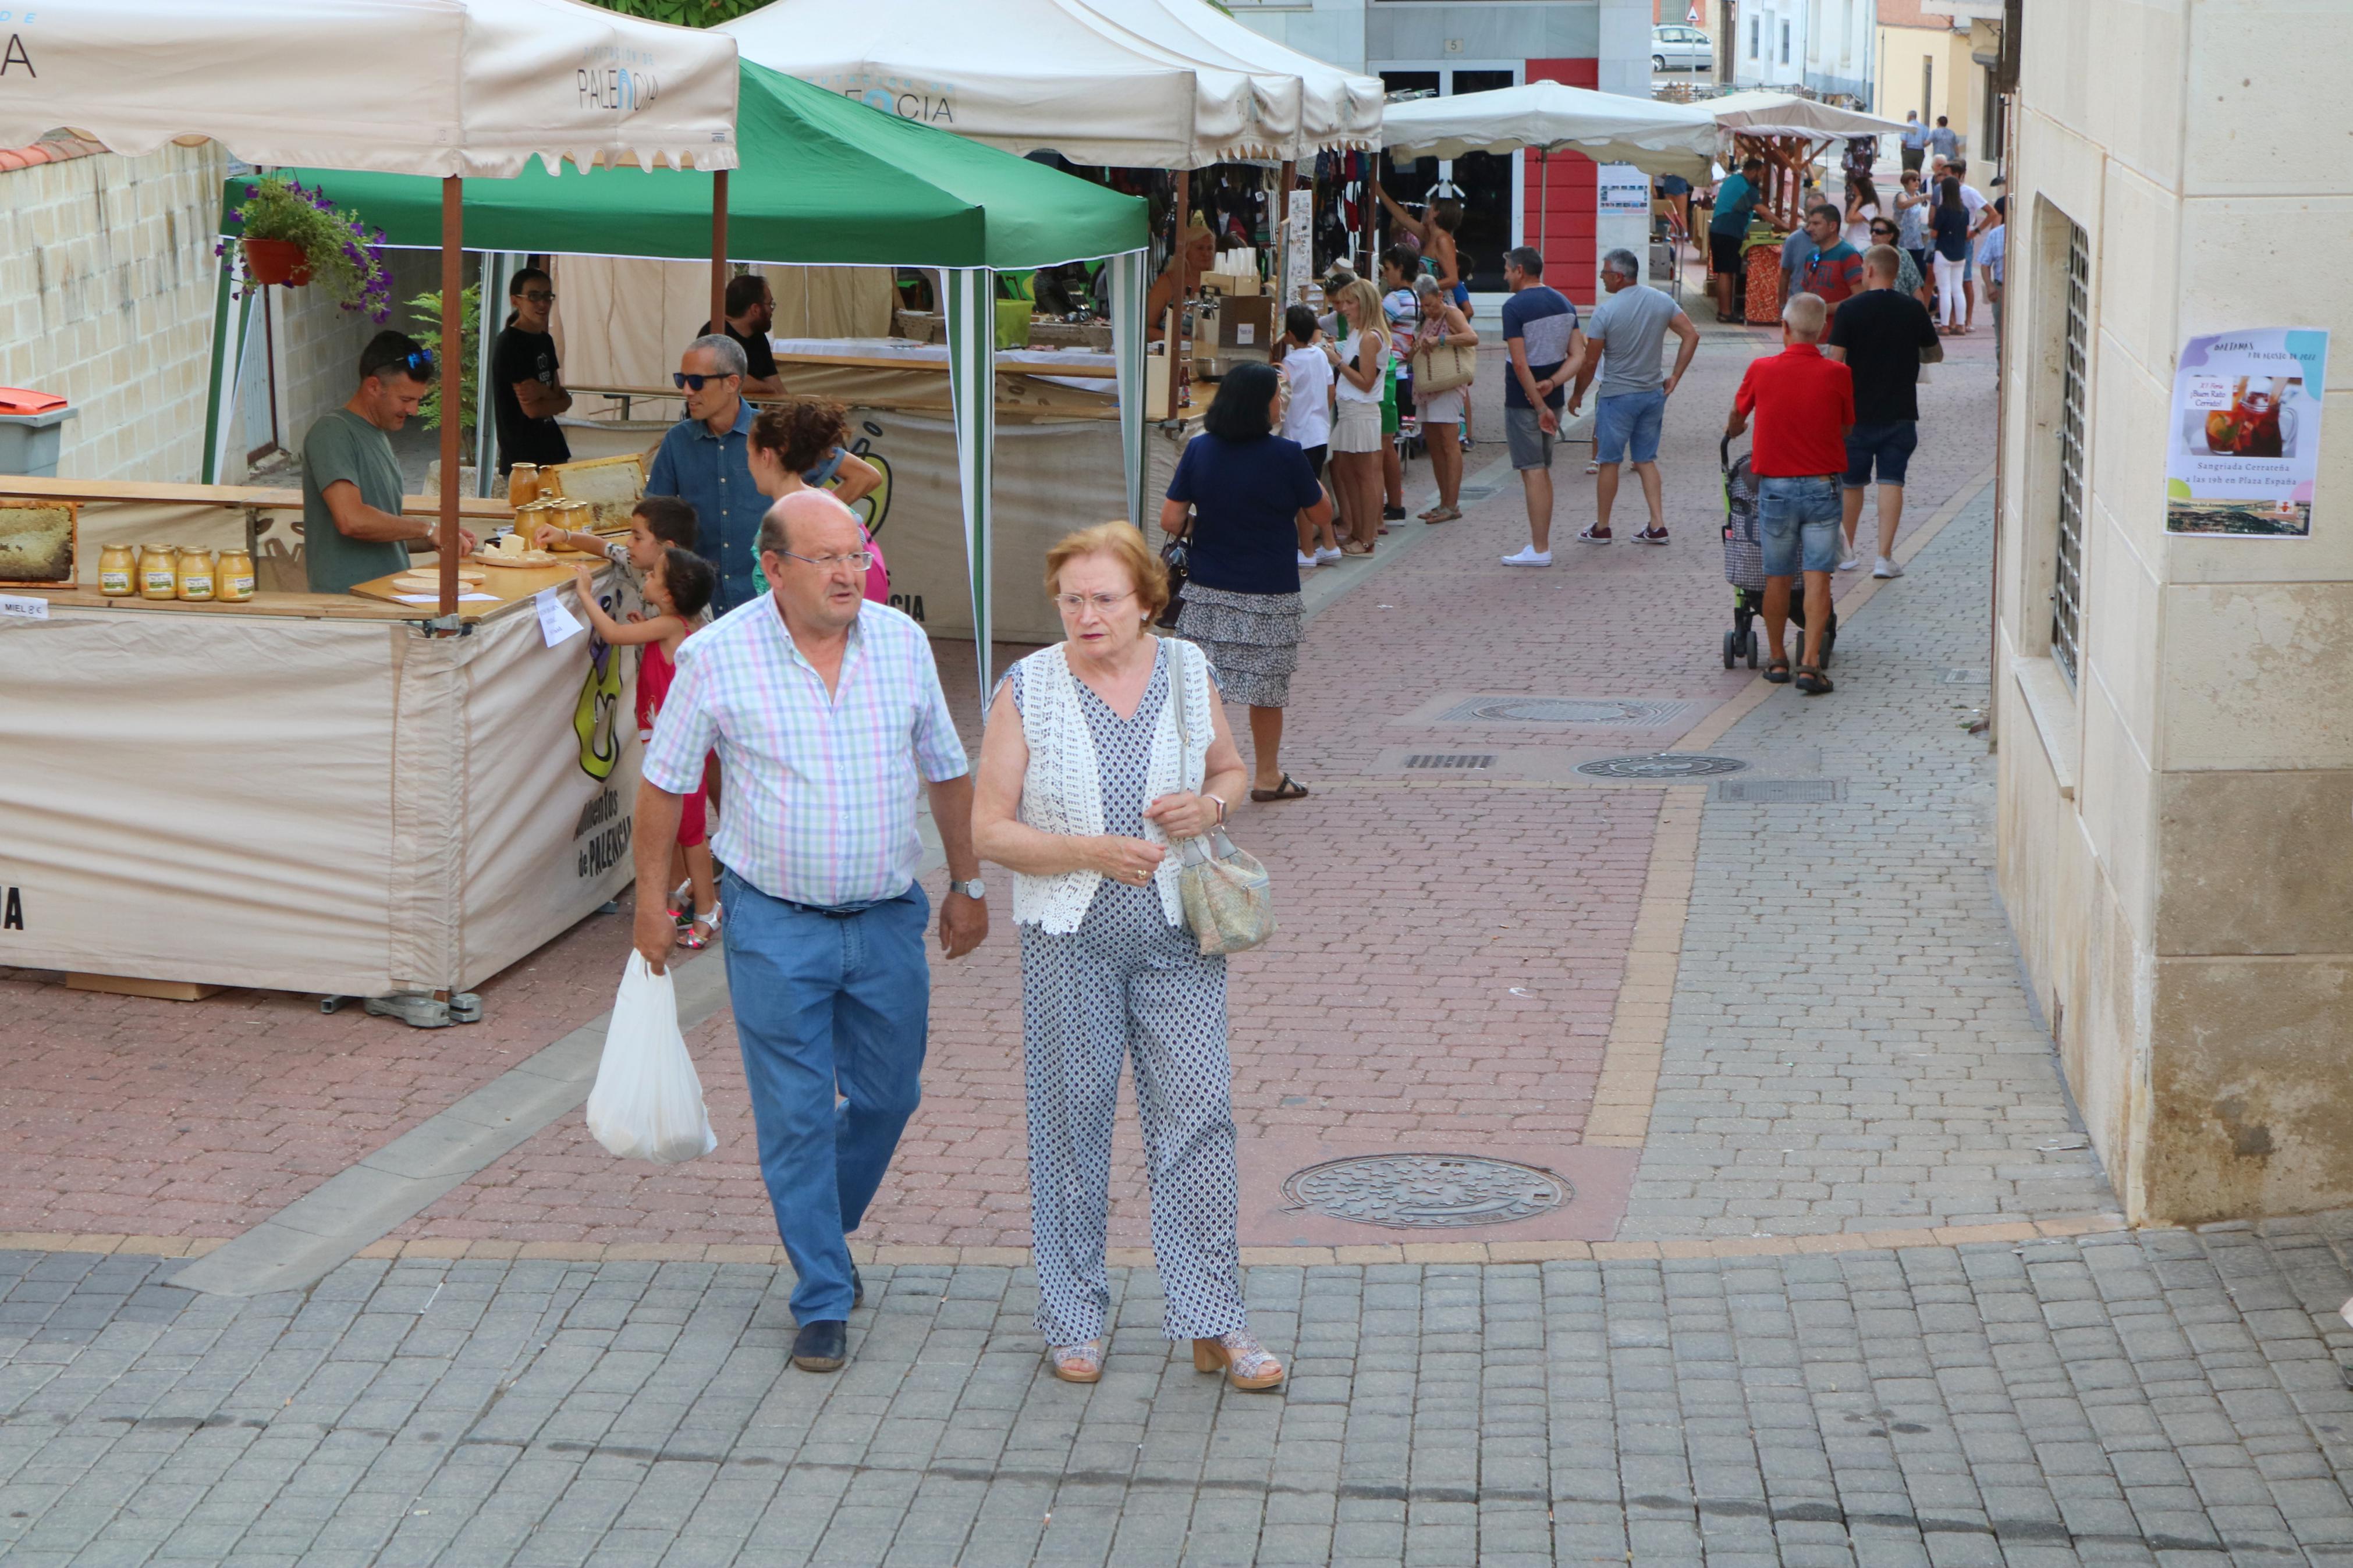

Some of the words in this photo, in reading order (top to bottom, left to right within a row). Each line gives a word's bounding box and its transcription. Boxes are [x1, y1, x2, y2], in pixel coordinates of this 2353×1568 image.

[1450, 40, 1457, 51] 5
[2198, 462, 2242, 472] Sangriada
[2245, 464, 2290, 472] Cerrateña
[2238, 477, 2262, 485] Plaza
[2265, 478, 2297, 486] España
[5, 603, 27, 613] MIEL
[579, 849, 588, 878] de
[589, 816, 632, 878] PALENCIA
